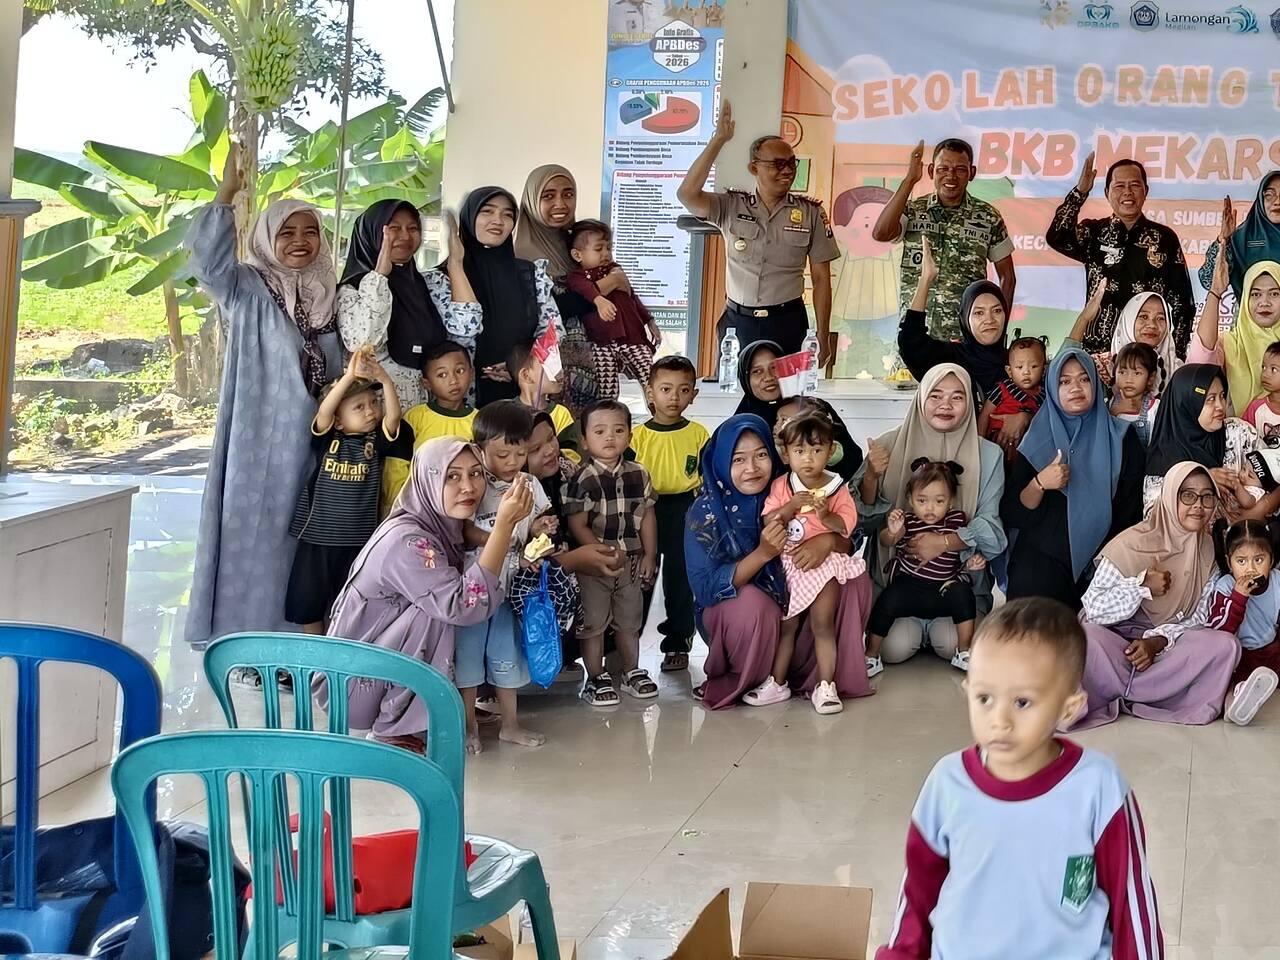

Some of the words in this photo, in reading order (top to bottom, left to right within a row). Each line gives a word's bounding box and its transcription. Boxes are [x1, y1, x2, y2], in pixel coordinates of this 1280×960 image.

[1165, 12, 1231, 26] Lamongan
[655, 39, 700, 51] APBDes
[665, 58, 689, 67] 2026
[978, 131, 1077, 177] BKB
[912, 222, 935, 231] HARI
[963, 228, 977, 238] TNI
[979, 232, 989, 241] AD
